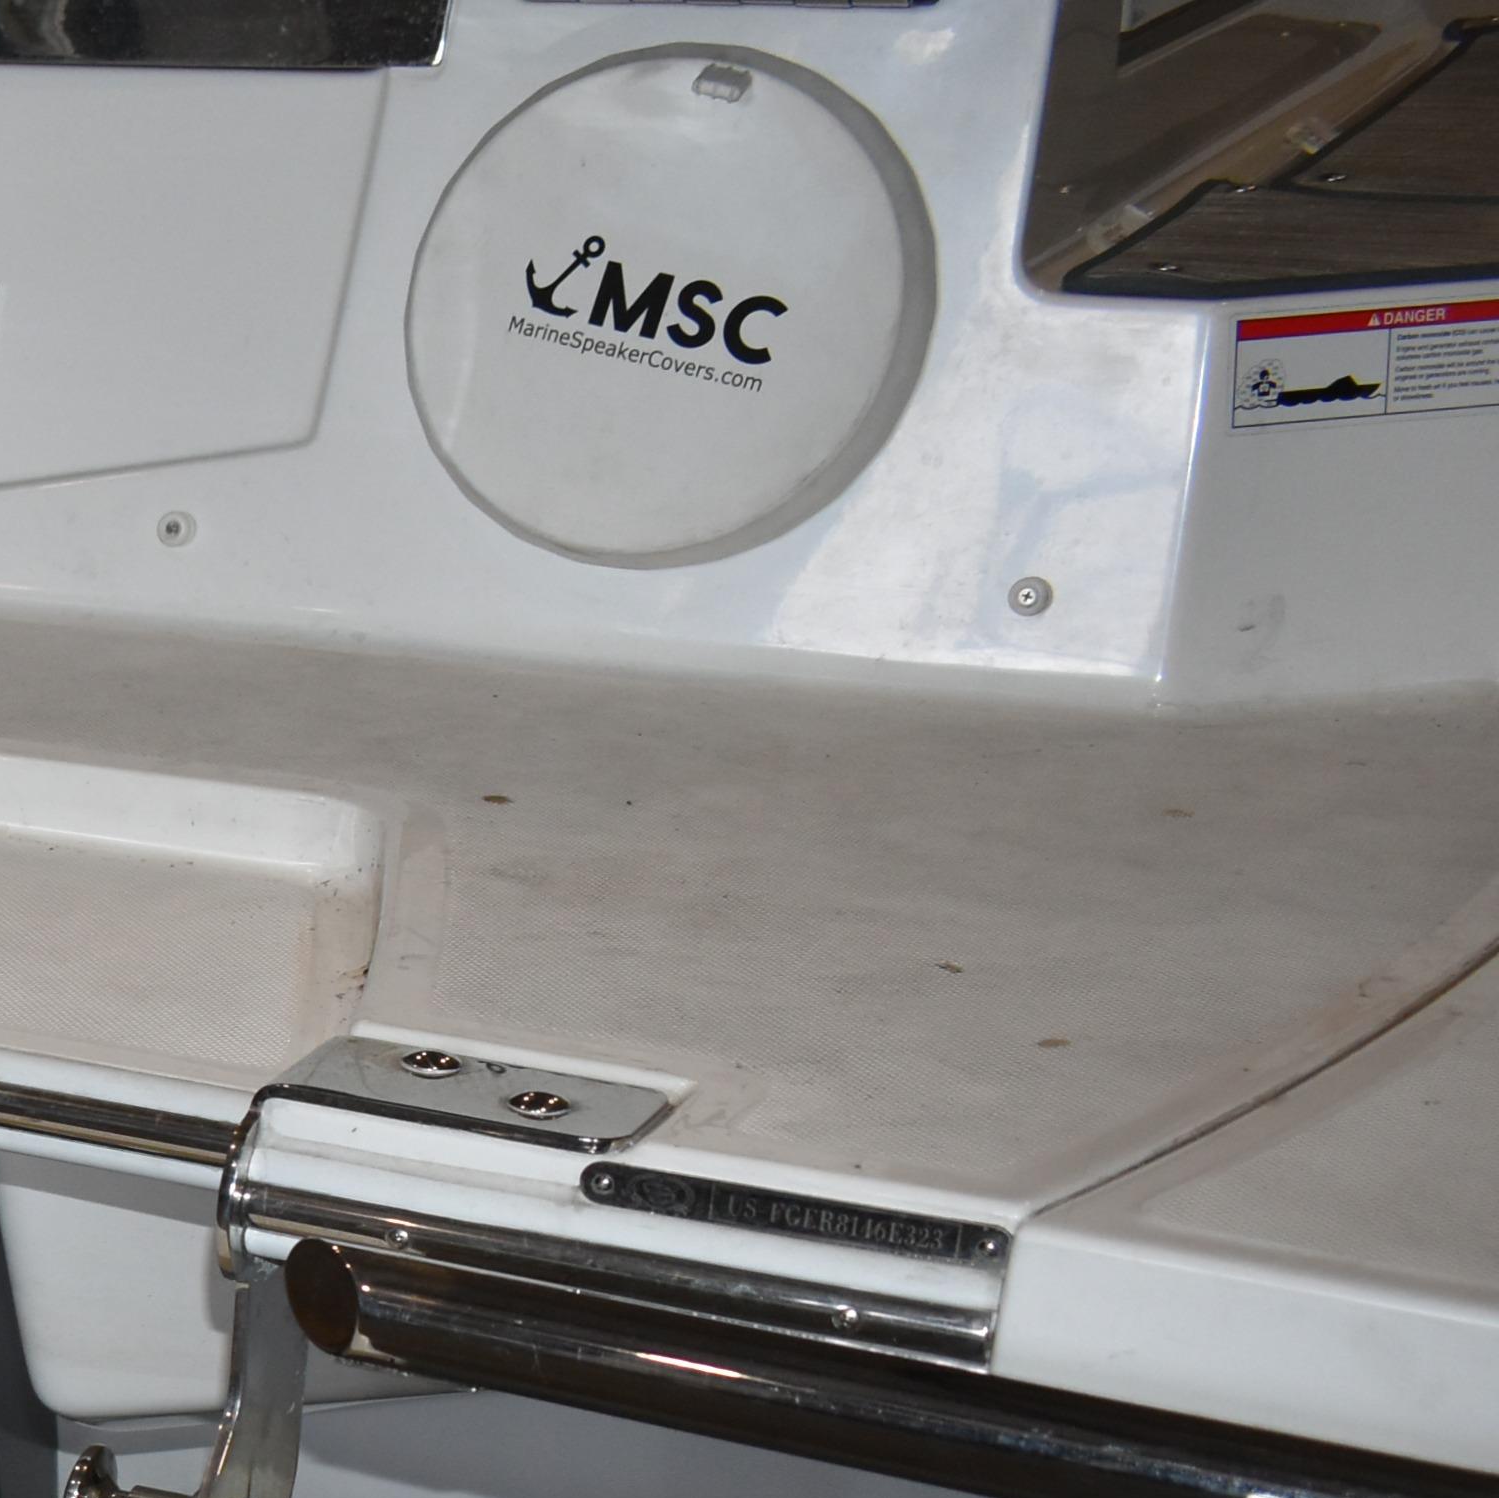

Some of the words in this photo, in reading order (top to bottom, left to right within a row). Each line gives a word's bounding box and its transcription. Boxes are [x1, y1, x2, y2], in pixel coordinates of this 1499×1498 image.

[588, 260, 788, 365] MSC
[1384, 308, 1446, 325] DANGER
[508, 315, 763, 393] MarineSpeakerCovers.com
